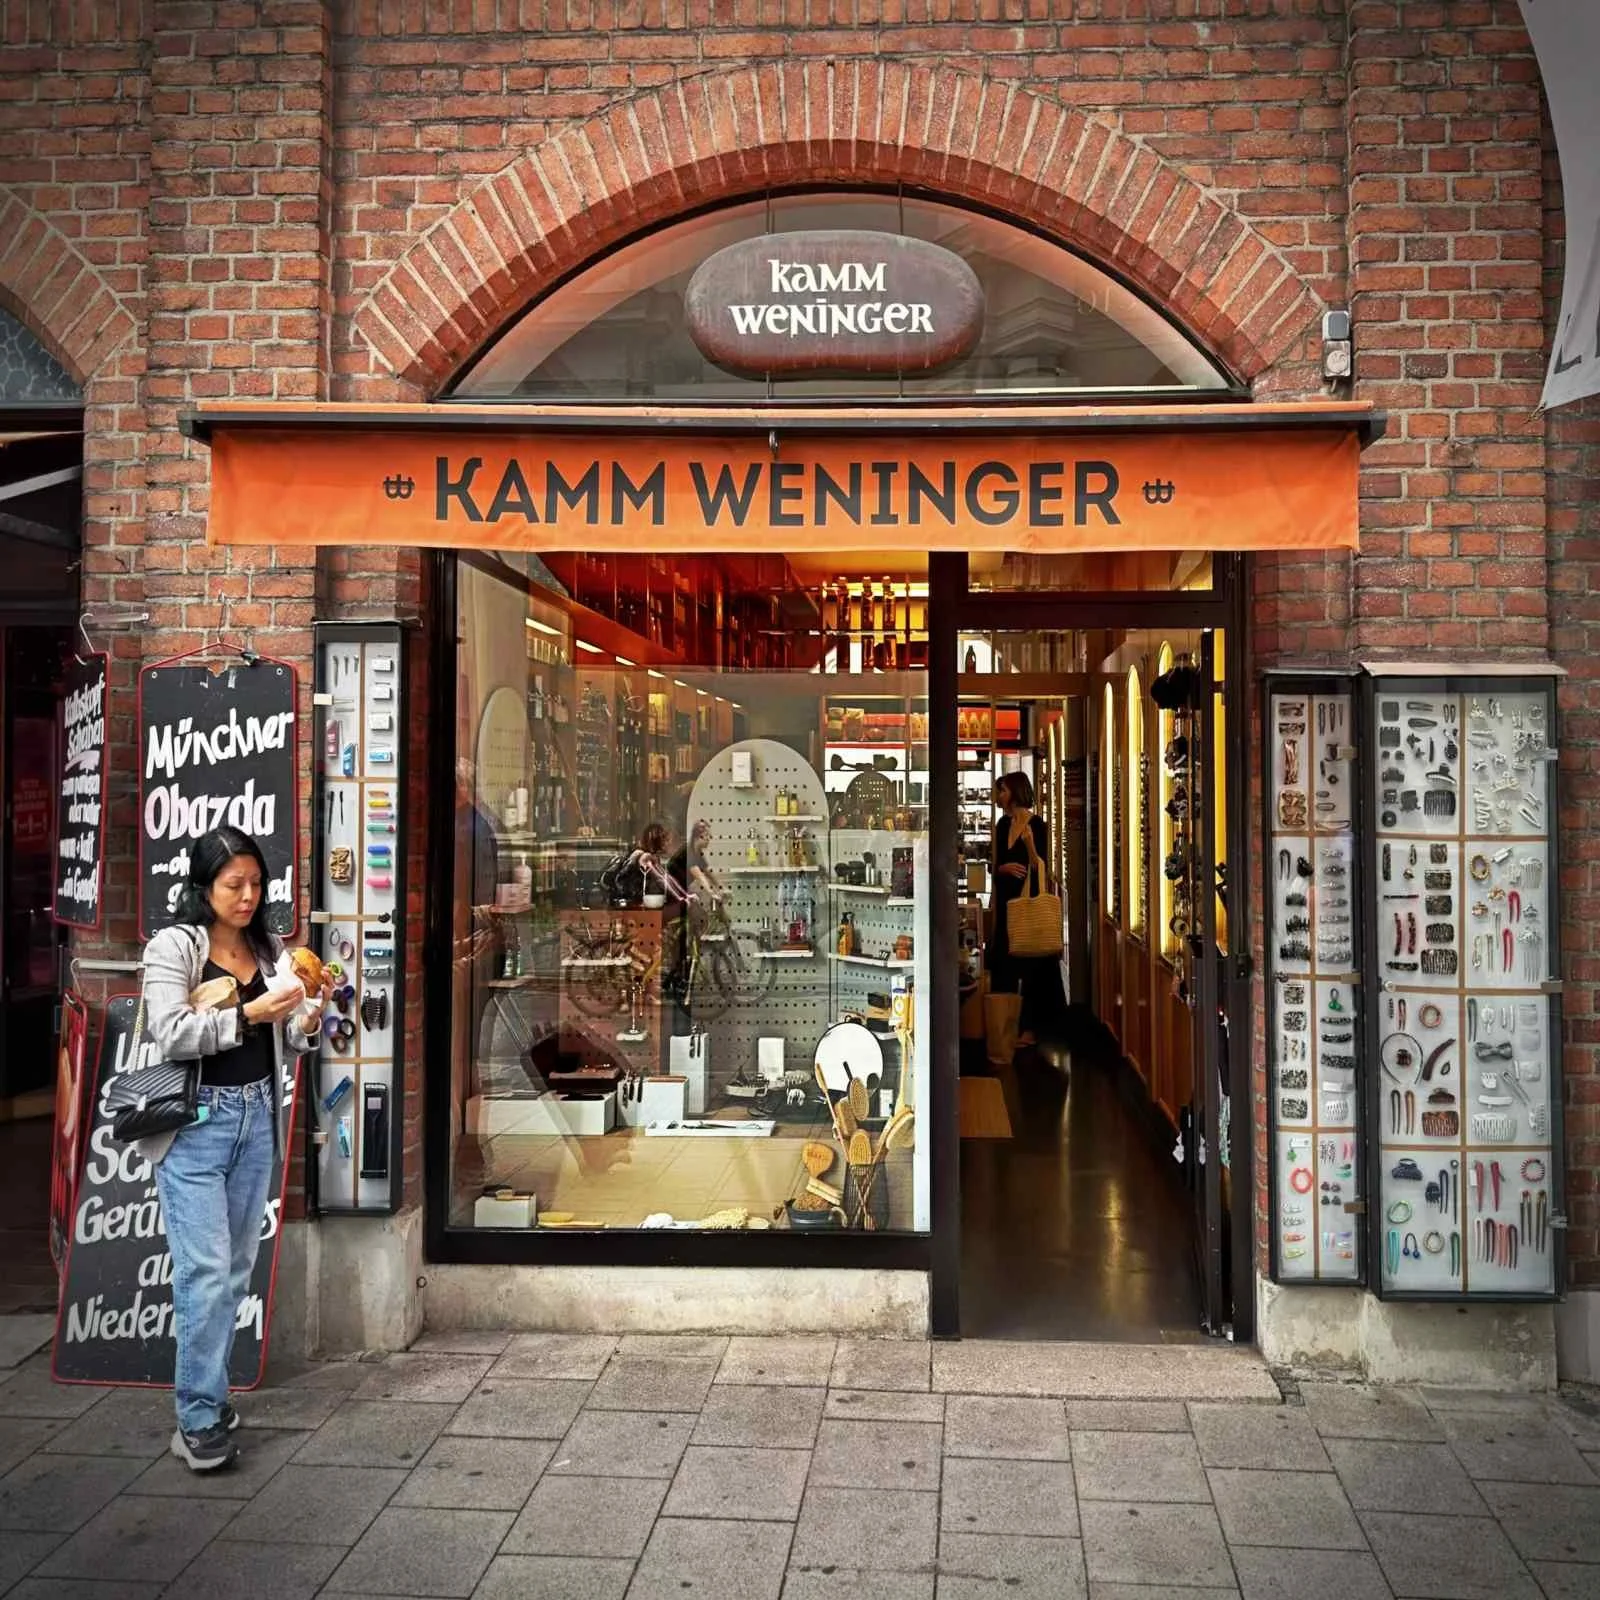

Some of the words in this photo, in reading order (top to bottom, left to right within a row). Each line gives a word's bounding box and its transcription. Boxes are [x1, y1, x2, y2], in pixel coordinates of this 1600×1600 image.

[435, 456, 666, 525] KAMM
[688, 460, 1122, 527] WENINGER
[145, 708, 295, 778] Münchner
[144, 779, 276, 841] Obazda
